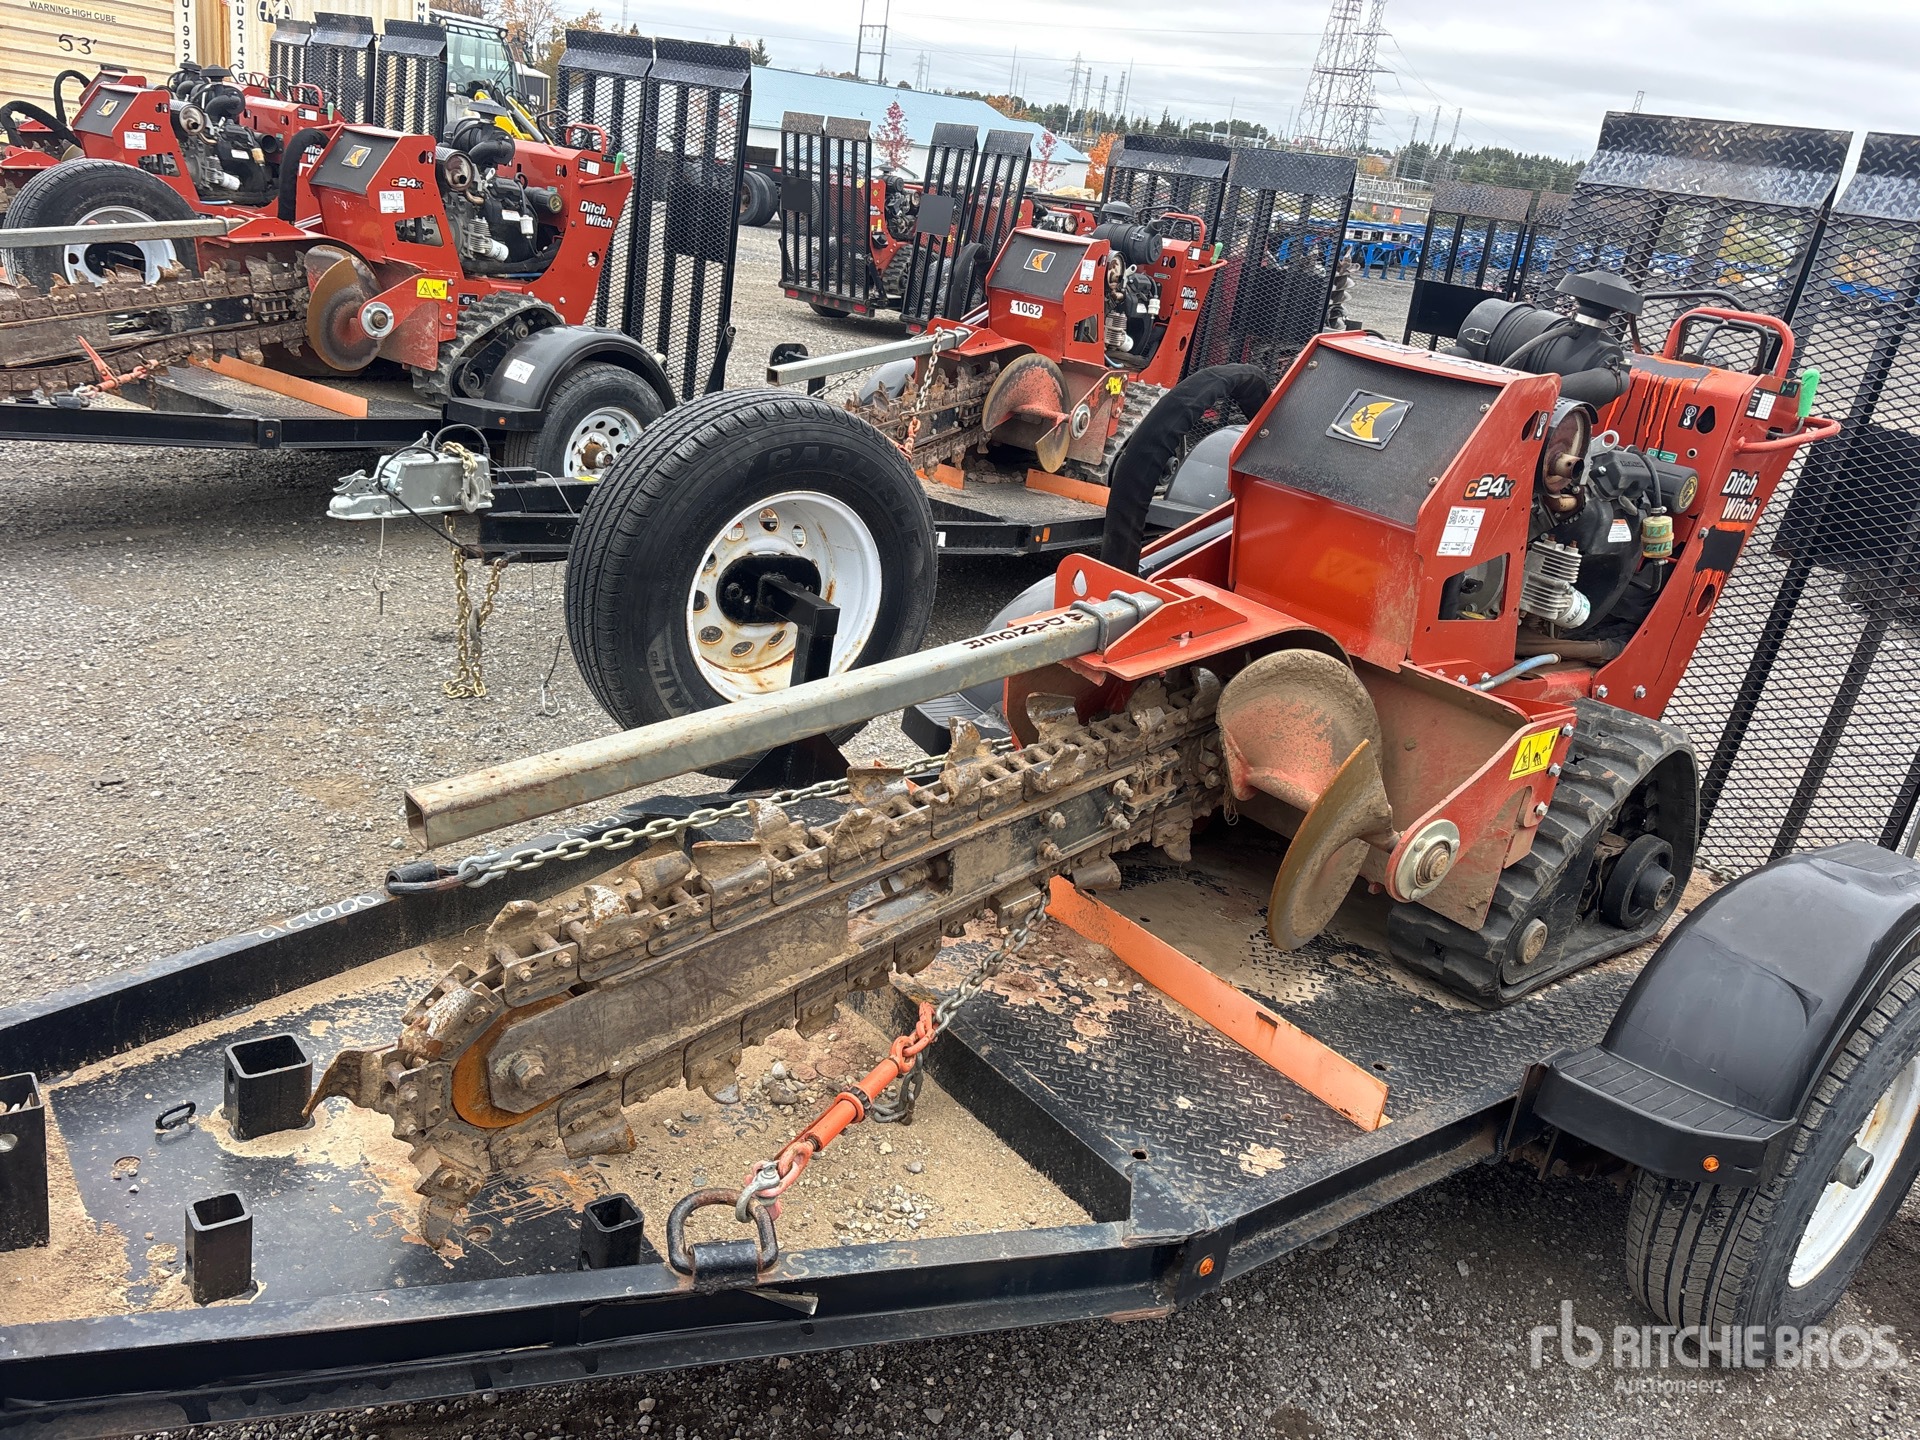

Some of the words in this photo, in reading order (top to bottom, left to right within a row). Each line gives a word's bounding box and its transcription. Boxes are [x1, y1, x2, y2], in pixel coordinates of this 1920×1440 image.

[29, 1, 70, 14] WARNING
[72, 9, 91, 19] HIGH
[94, 13, 116, 22] CUBE
[580, 201, 607, 215] Ditch
[585, 214, 613, 228] Witch
[1181, 287, 1197, 298] Ditch
[1015, 302, 1041, 316] 1062
[1183, 298, 1199, 309] Witch
[1721, 470, 1759, 496] Ditch
[1721, 497, 1761, 521] Witch
[962, 616, 1065, 650] DANGER
